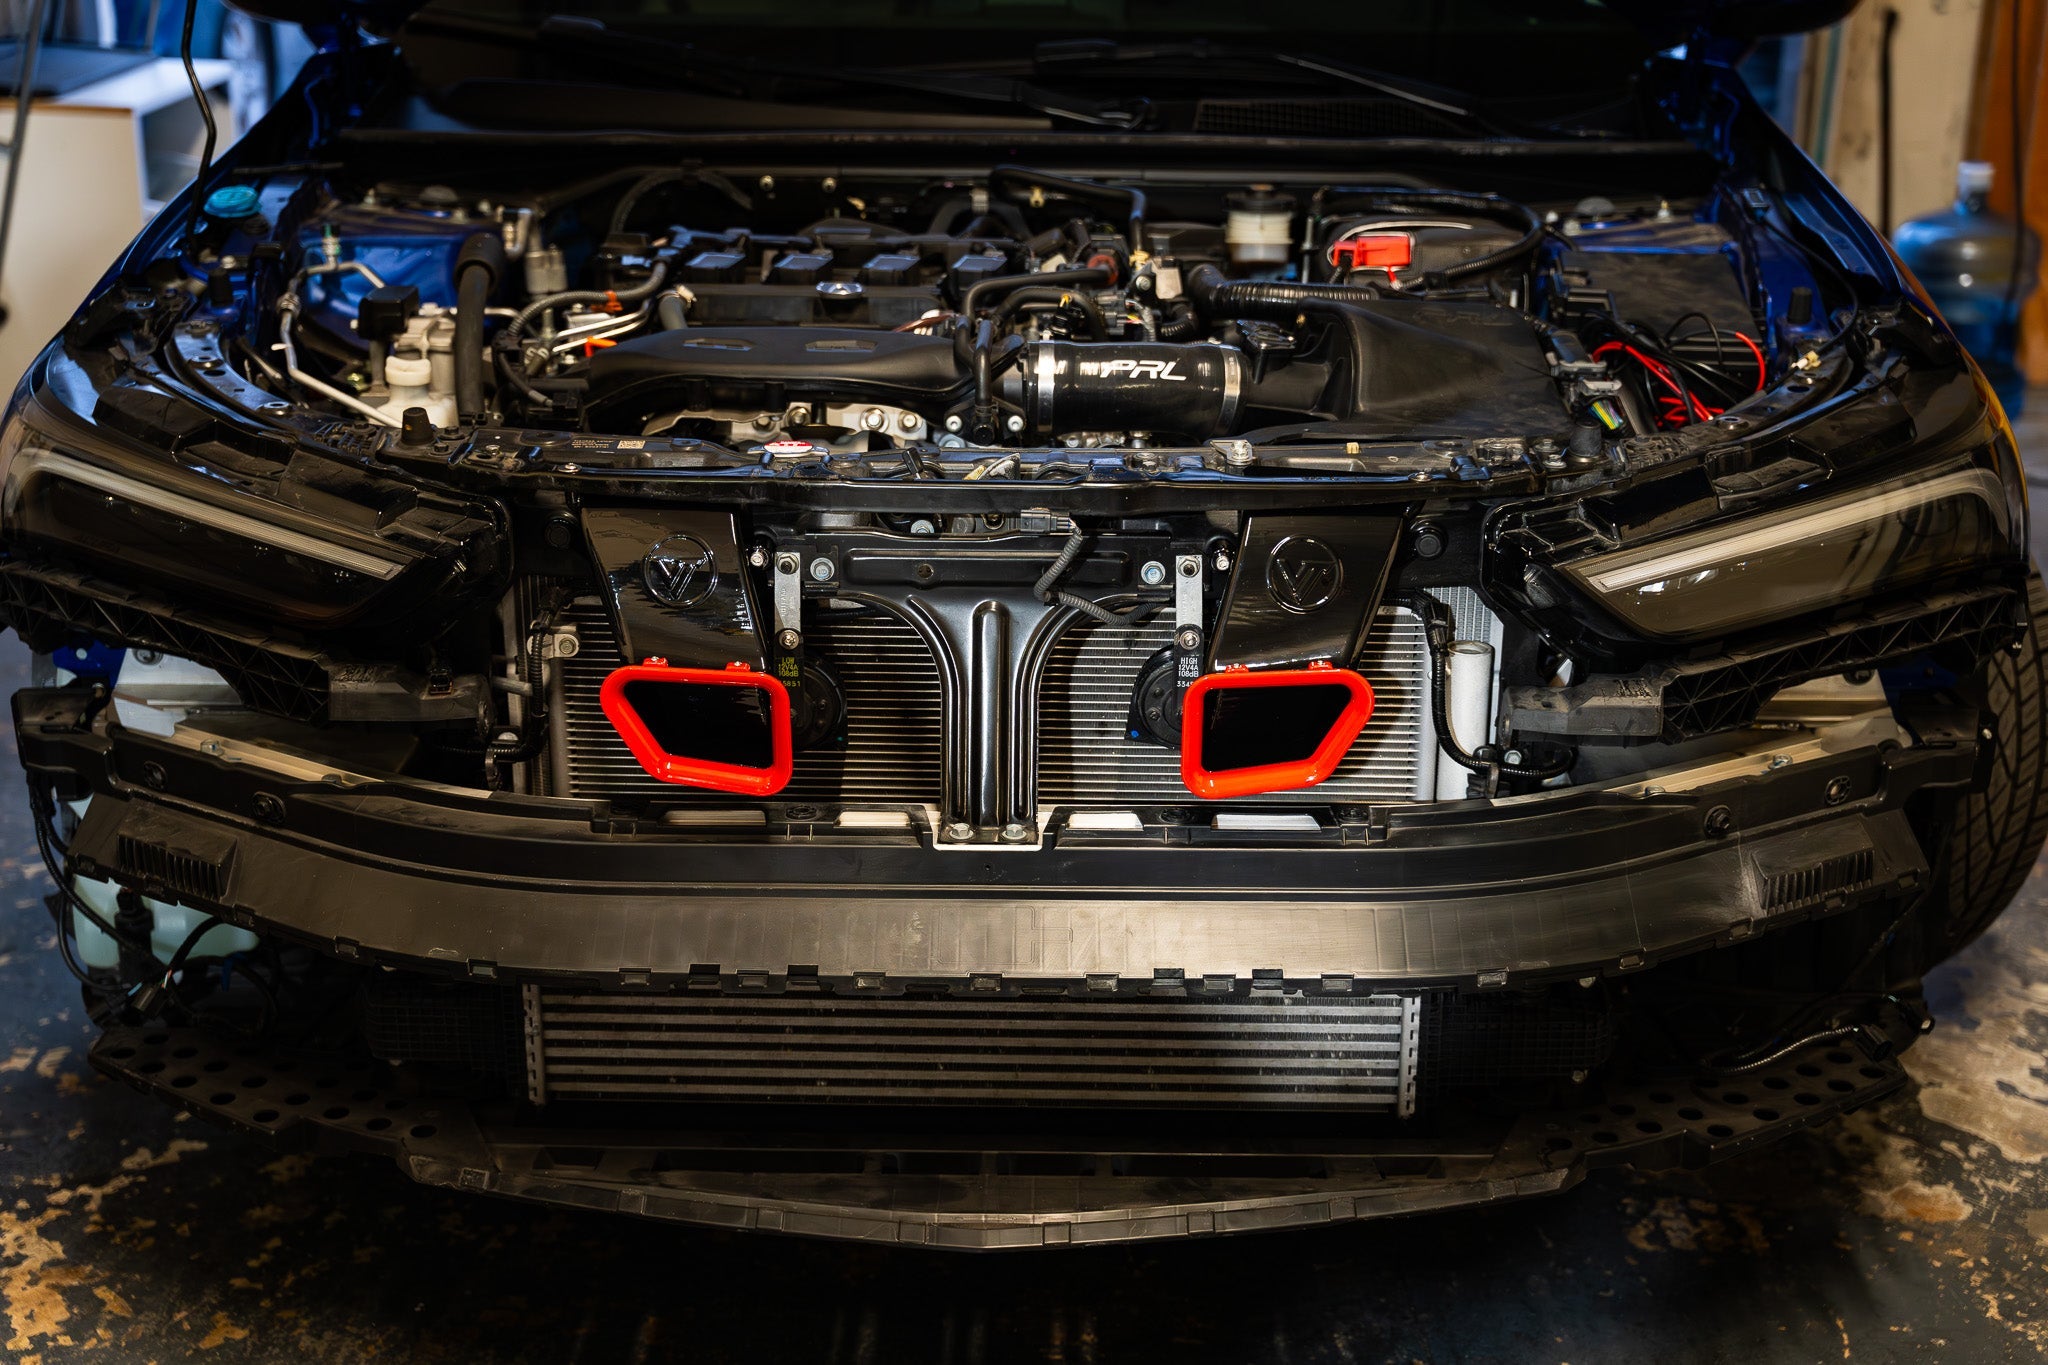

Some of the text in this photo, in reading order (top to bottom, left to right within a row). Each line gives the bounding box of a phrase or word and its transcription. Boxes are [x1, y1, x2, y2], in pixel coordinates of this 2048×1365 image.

[1100, 358, 1187, 381] PRL
[1180, 657, 1198, 665] HIGH
[1178, 670, 1199, 678] 108dB
